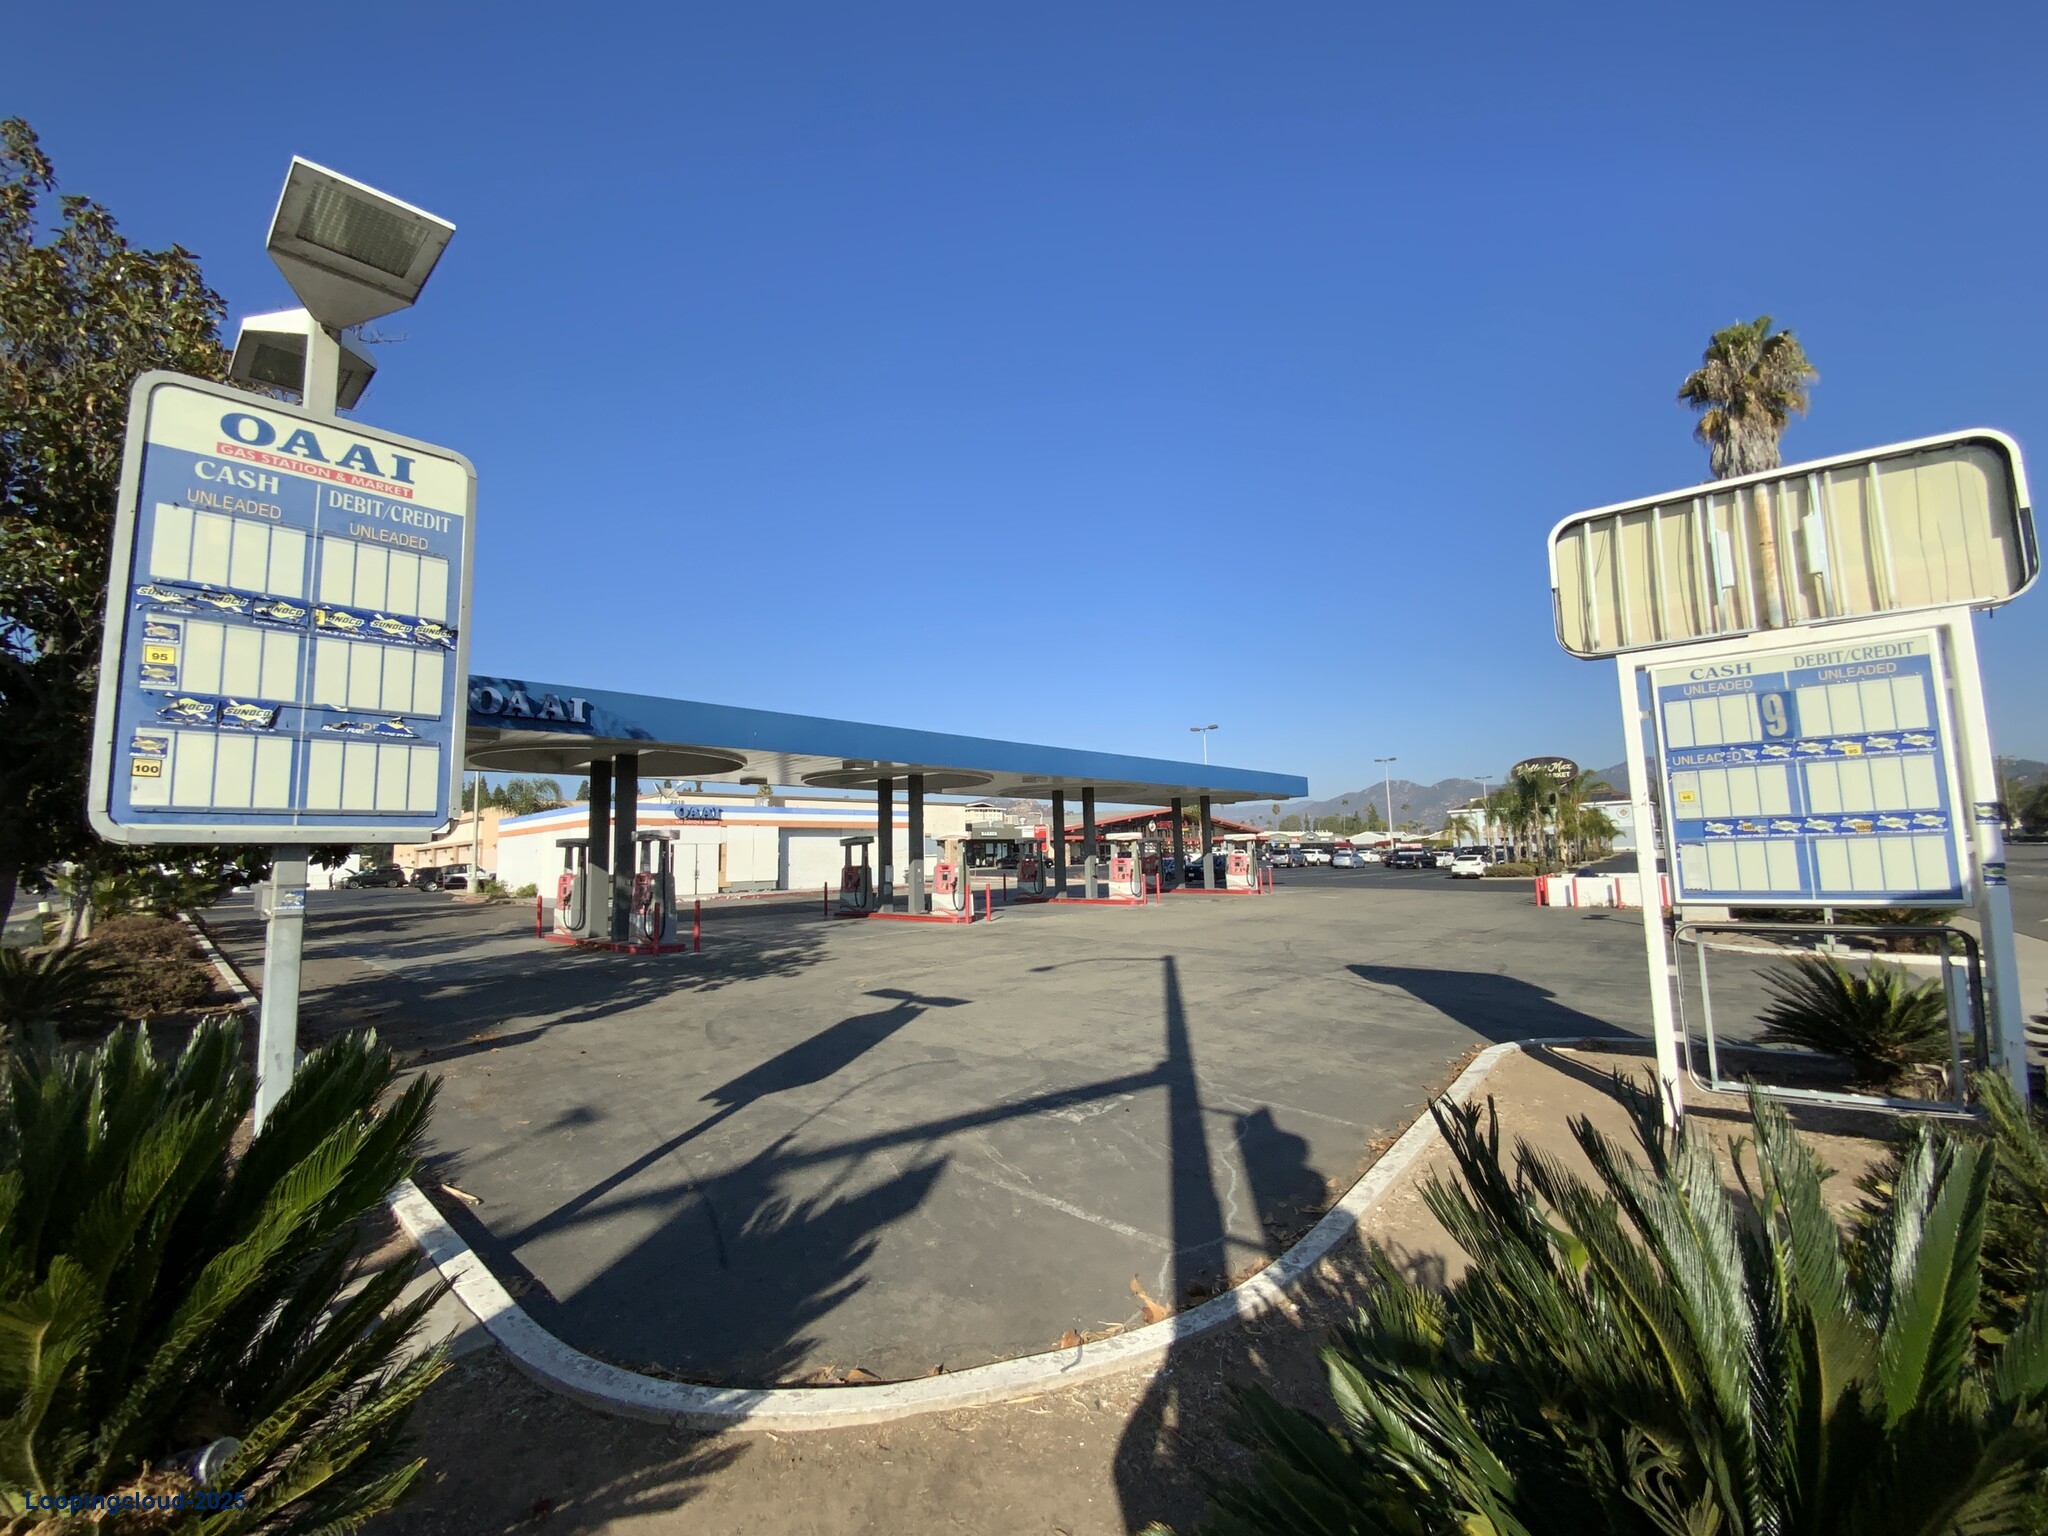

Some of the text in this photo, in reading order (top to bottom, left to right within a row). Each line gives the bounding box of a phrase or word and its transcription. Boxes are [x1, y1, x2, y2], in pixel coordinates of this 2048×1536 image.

[220, 412, 416, 485] OAAI
[194, 460, 280, 495] CASH
[218, 443, 411, 498] GAS STATION & MARKET
[187, 487, 282, 520] UNLEADED
[328, 489, 452, 534] DEBIT/CREDIT
[348, 522, 428, 551] UNLEADED
[373, 621, 412, 633] SUNOCO
[152, 652, 168, 661] 95
[1793, 641, 1914, 668] DEBIT/CREDIT
[1690, 662, 1752, 680] CASH
[1818, 662, 1897, 681] UNLEADED
[1684, 679, 1753, 696] UNLEADED
[225, 707, 272, 718] SUNOCO
[469, 685, 586, 724] OAAI
[1761, 693, 1788, 737] 9
[135, 764, 159, 773] 100
[674, 805, 723, 819] OAAI
